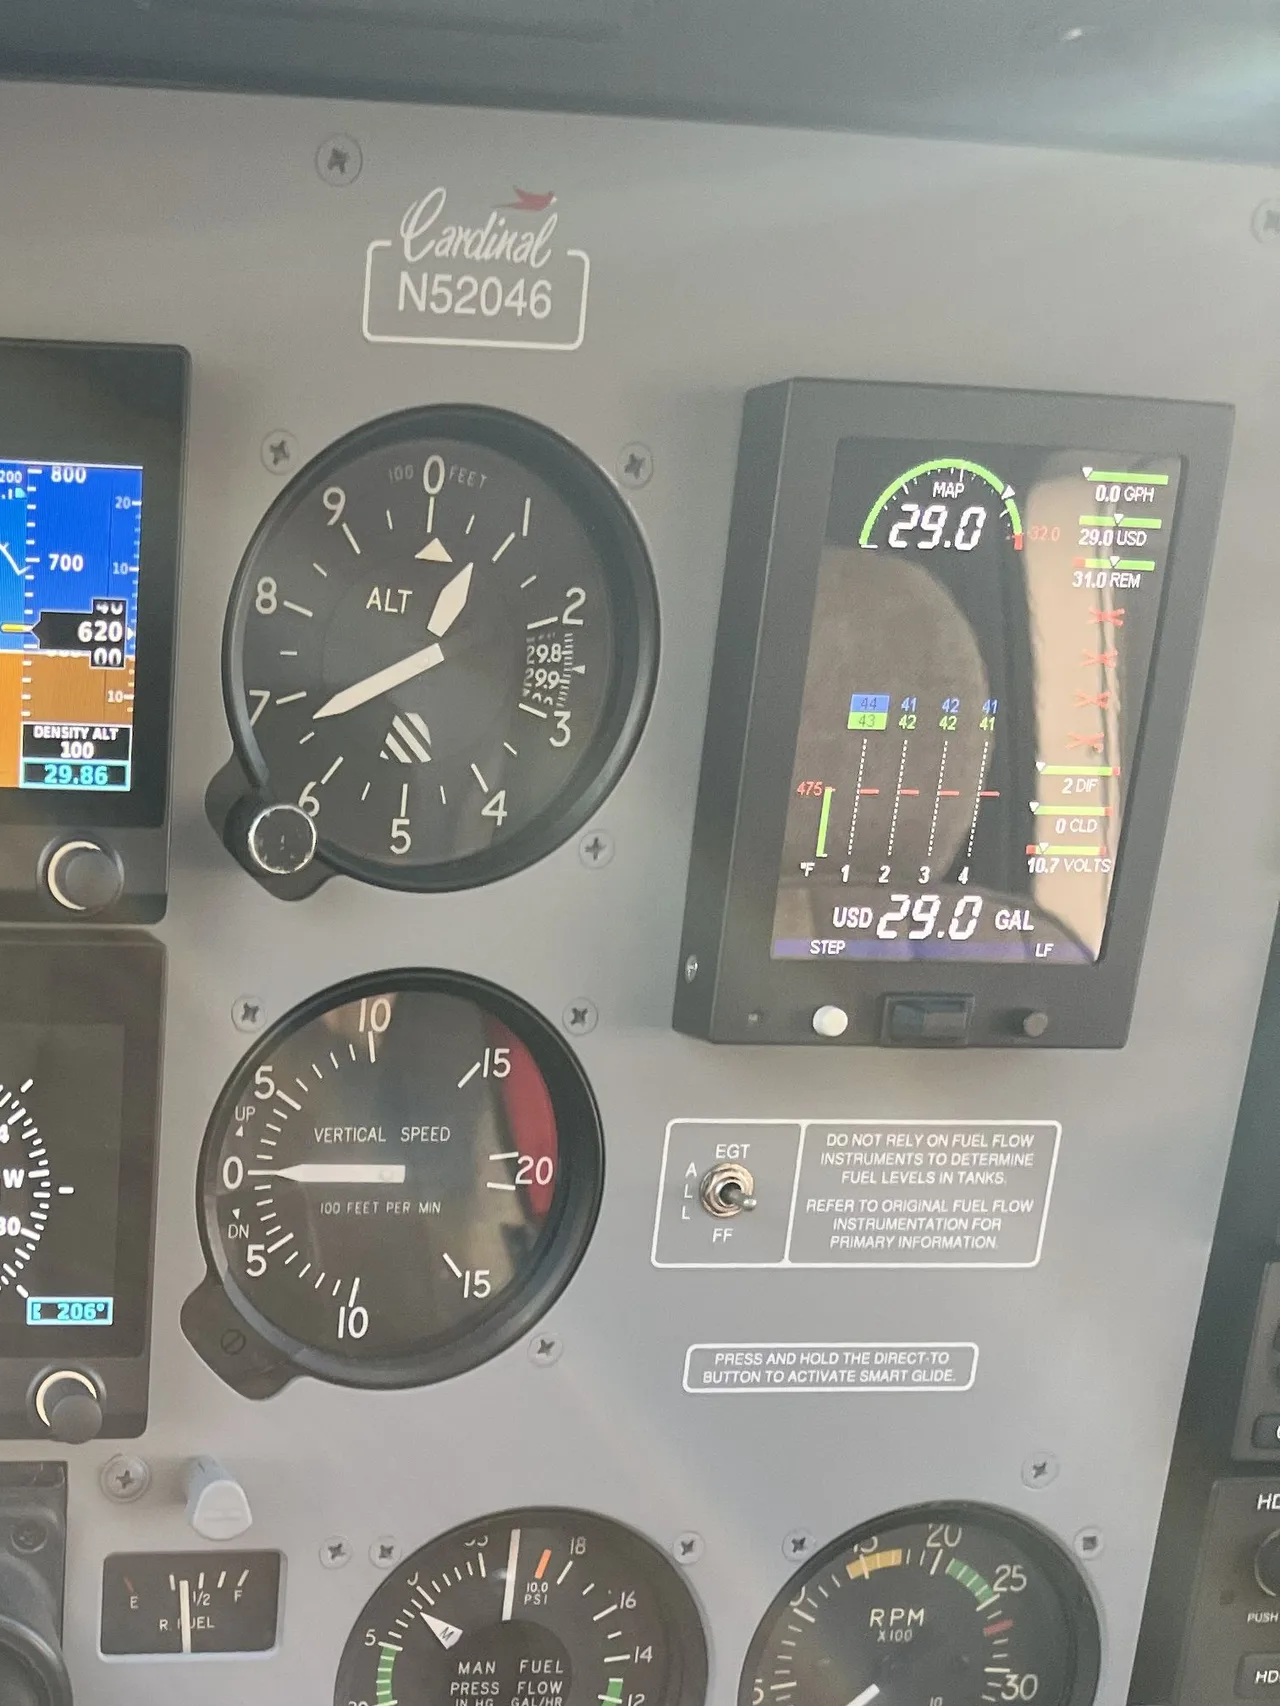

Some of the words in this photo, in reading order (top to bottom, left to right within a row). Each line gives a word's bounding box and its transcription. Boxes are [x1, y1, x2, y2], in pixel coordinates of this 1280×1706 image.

[399, 186, 558, 269] Cardinal
[398, 271, 552, 319] N52046
[50, 466, 86, 484] 800
[932, 481, 965, 498] MAP
[1124, 486, 1155, 503] GPH
[888, 503, 986, 551] 29.0
[1117, 530, 1147, 547] USD
[48, 554, 84, 572] 700
[1110, 572, 1141, 589] REM
[366, 587, 413, 614] ALT
[77, 620, 123, 643] 620
[33, 725, 89, 739] DENSITY
[92, 727, 119, 740] ALT
[60, 741, 95, 759] 100
[43, 764, 108, 785] 29.86
[1076, 778, 1099, 794] DIF
[1069, 817, 1098, 834] CLD
[1063, 858, 1112, 874] VOLTS
[832, 906, 873, 928] USD
[876, 894, 984, 940] 29.0
[995, 909, 1035, 931] GAL
[810, 939, 846, 957] STEP
[1035, 942, 1054, 957] LF
[359, 998, 392, 1033] 10
[483, 1047, 512, 1078] 15
[235, 1106, 255, 1122] UP
[315, 1127, 386, 1142] VERTICAL
[400, 1127, 450, 1142] SPEED
[826, 1134, 848, 1147] DO
[852, 1134, 882, 1147] NOT
[886, 1134, 923, 1147] RELY
[927, 1134, 948, 1147] ON
[952, 1135, 988, 1147] FUEL
[992, 1134, 1034, 1147] FLOW
[715, 1144, 749, 1159] EGT
[820, 1152, 923, 1166] INSTRUMENTS
[928, 1153, 947, 1166] TO
[951, 1153, 1034, 1167] DETERMINE
[515, 1156, 553, 1185] 20
[841, 1171, 877, 1184] FUEL
[881, 1171, 935, 1184] LEVELS
[939, 1172, 953, 1184] IN
[958, 1172, 1007, 1185] TANKS.
[346, 1202, 379, 1214] FEET
[386, 1202, 411, 1214] PER
[419, 1202, 441, 1214] MIN
[806, 1199, 854, 1213] REFER
[859, 1199, 878, 1212] TO
[882, 1200, 948, 1213] ORIGINAL
[952, 1200, 988, 1213] FUEL
[992, 1200, 1034, 1213] FLOW
[228, 1224, 250, 1239] DN
[833, 1218, 968, 1231] INSTRUMENTATION
[972, 1218, 1002, 1231] FOR
[713, 1229, 733, 1244] FF
[830, 1236, 895, 1249] PRIMARY
[463, 1271, 491, 1298] 15
[338, 1306, 369, 1338] 10
[715, 1353, 763, 1366] PRESS
[766, 1353, 796, 1365] AND
[800, 1353, 839, 1365] HOLD
[843, 1353, 871, 1364] THE
[875, 1352, 949, 1365] DIRECT-TO
[703, 1371, 761, 1384] BUTTON
[765, 1371, 784, 1383] TO
[787, 1370, 856, 1383] ACTIVATE
[860, 1370, 908, 1383] SMART
[993, 1565, 1027, 1592] 25
[524, 1594, 548, 1605] PSI
[869, 1608, 924, 1626] RPM
[1247, 1613, 1279, 1623] PUSH
[459, 1661, 496, 1675] MAN
[520, 1660, 564, 1675] FUEL
[450, 1682, 500, 1696] PRESS
[517, 1682, 563, 1695] FLOW
[1001, 1674, 1038, 1701] 30
